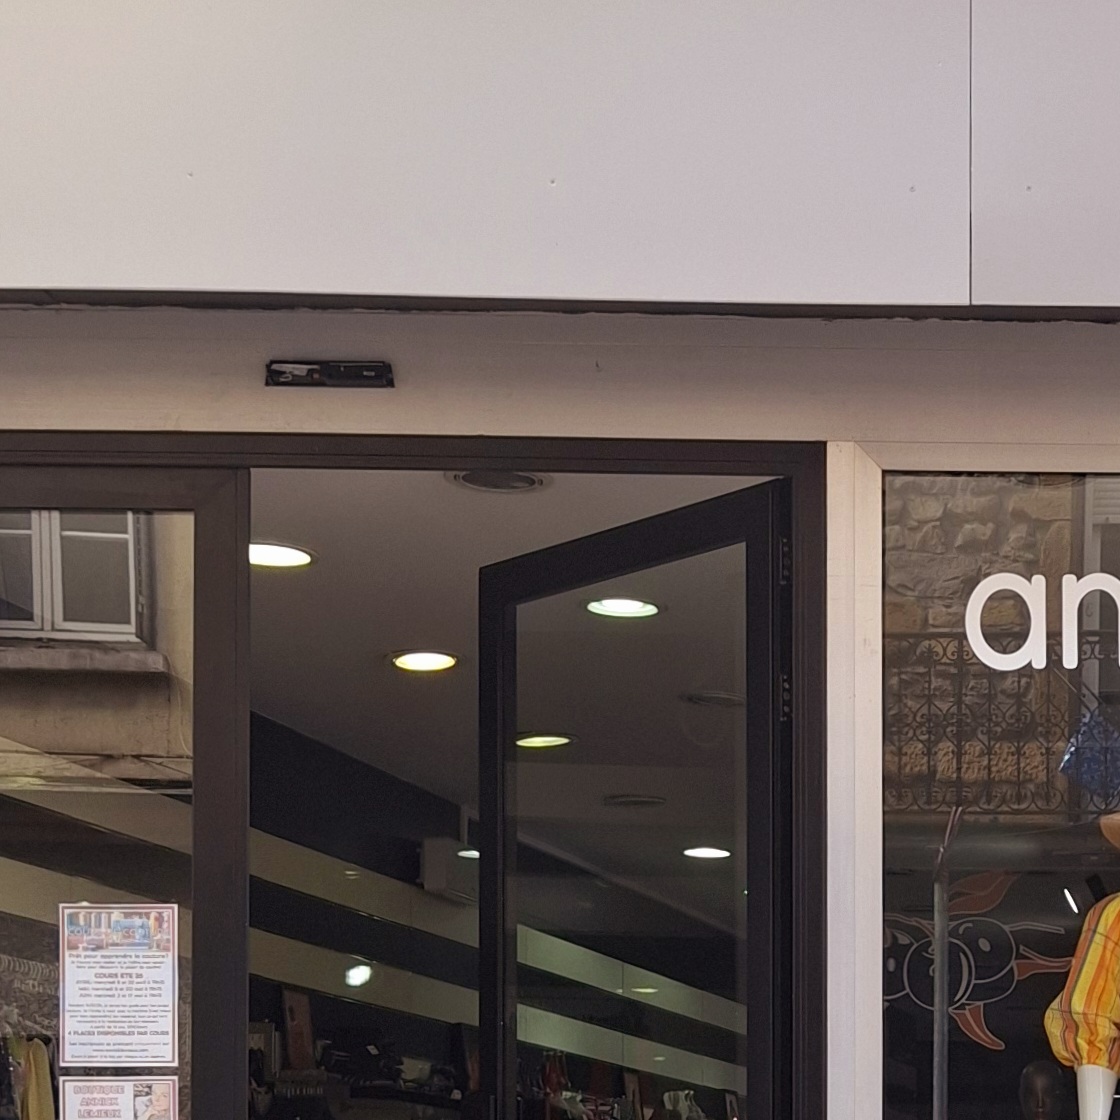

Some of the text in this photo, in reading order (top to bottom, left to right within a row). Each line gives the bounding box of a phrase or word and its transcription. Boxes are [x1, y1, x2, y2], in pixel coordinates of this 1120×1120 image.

[74, 1085, 124, 1095] BOUTIQUE
[80, 1097, 119, 1106] ANNICK
[78, 1109, 121, 1118] LEMIEUX
